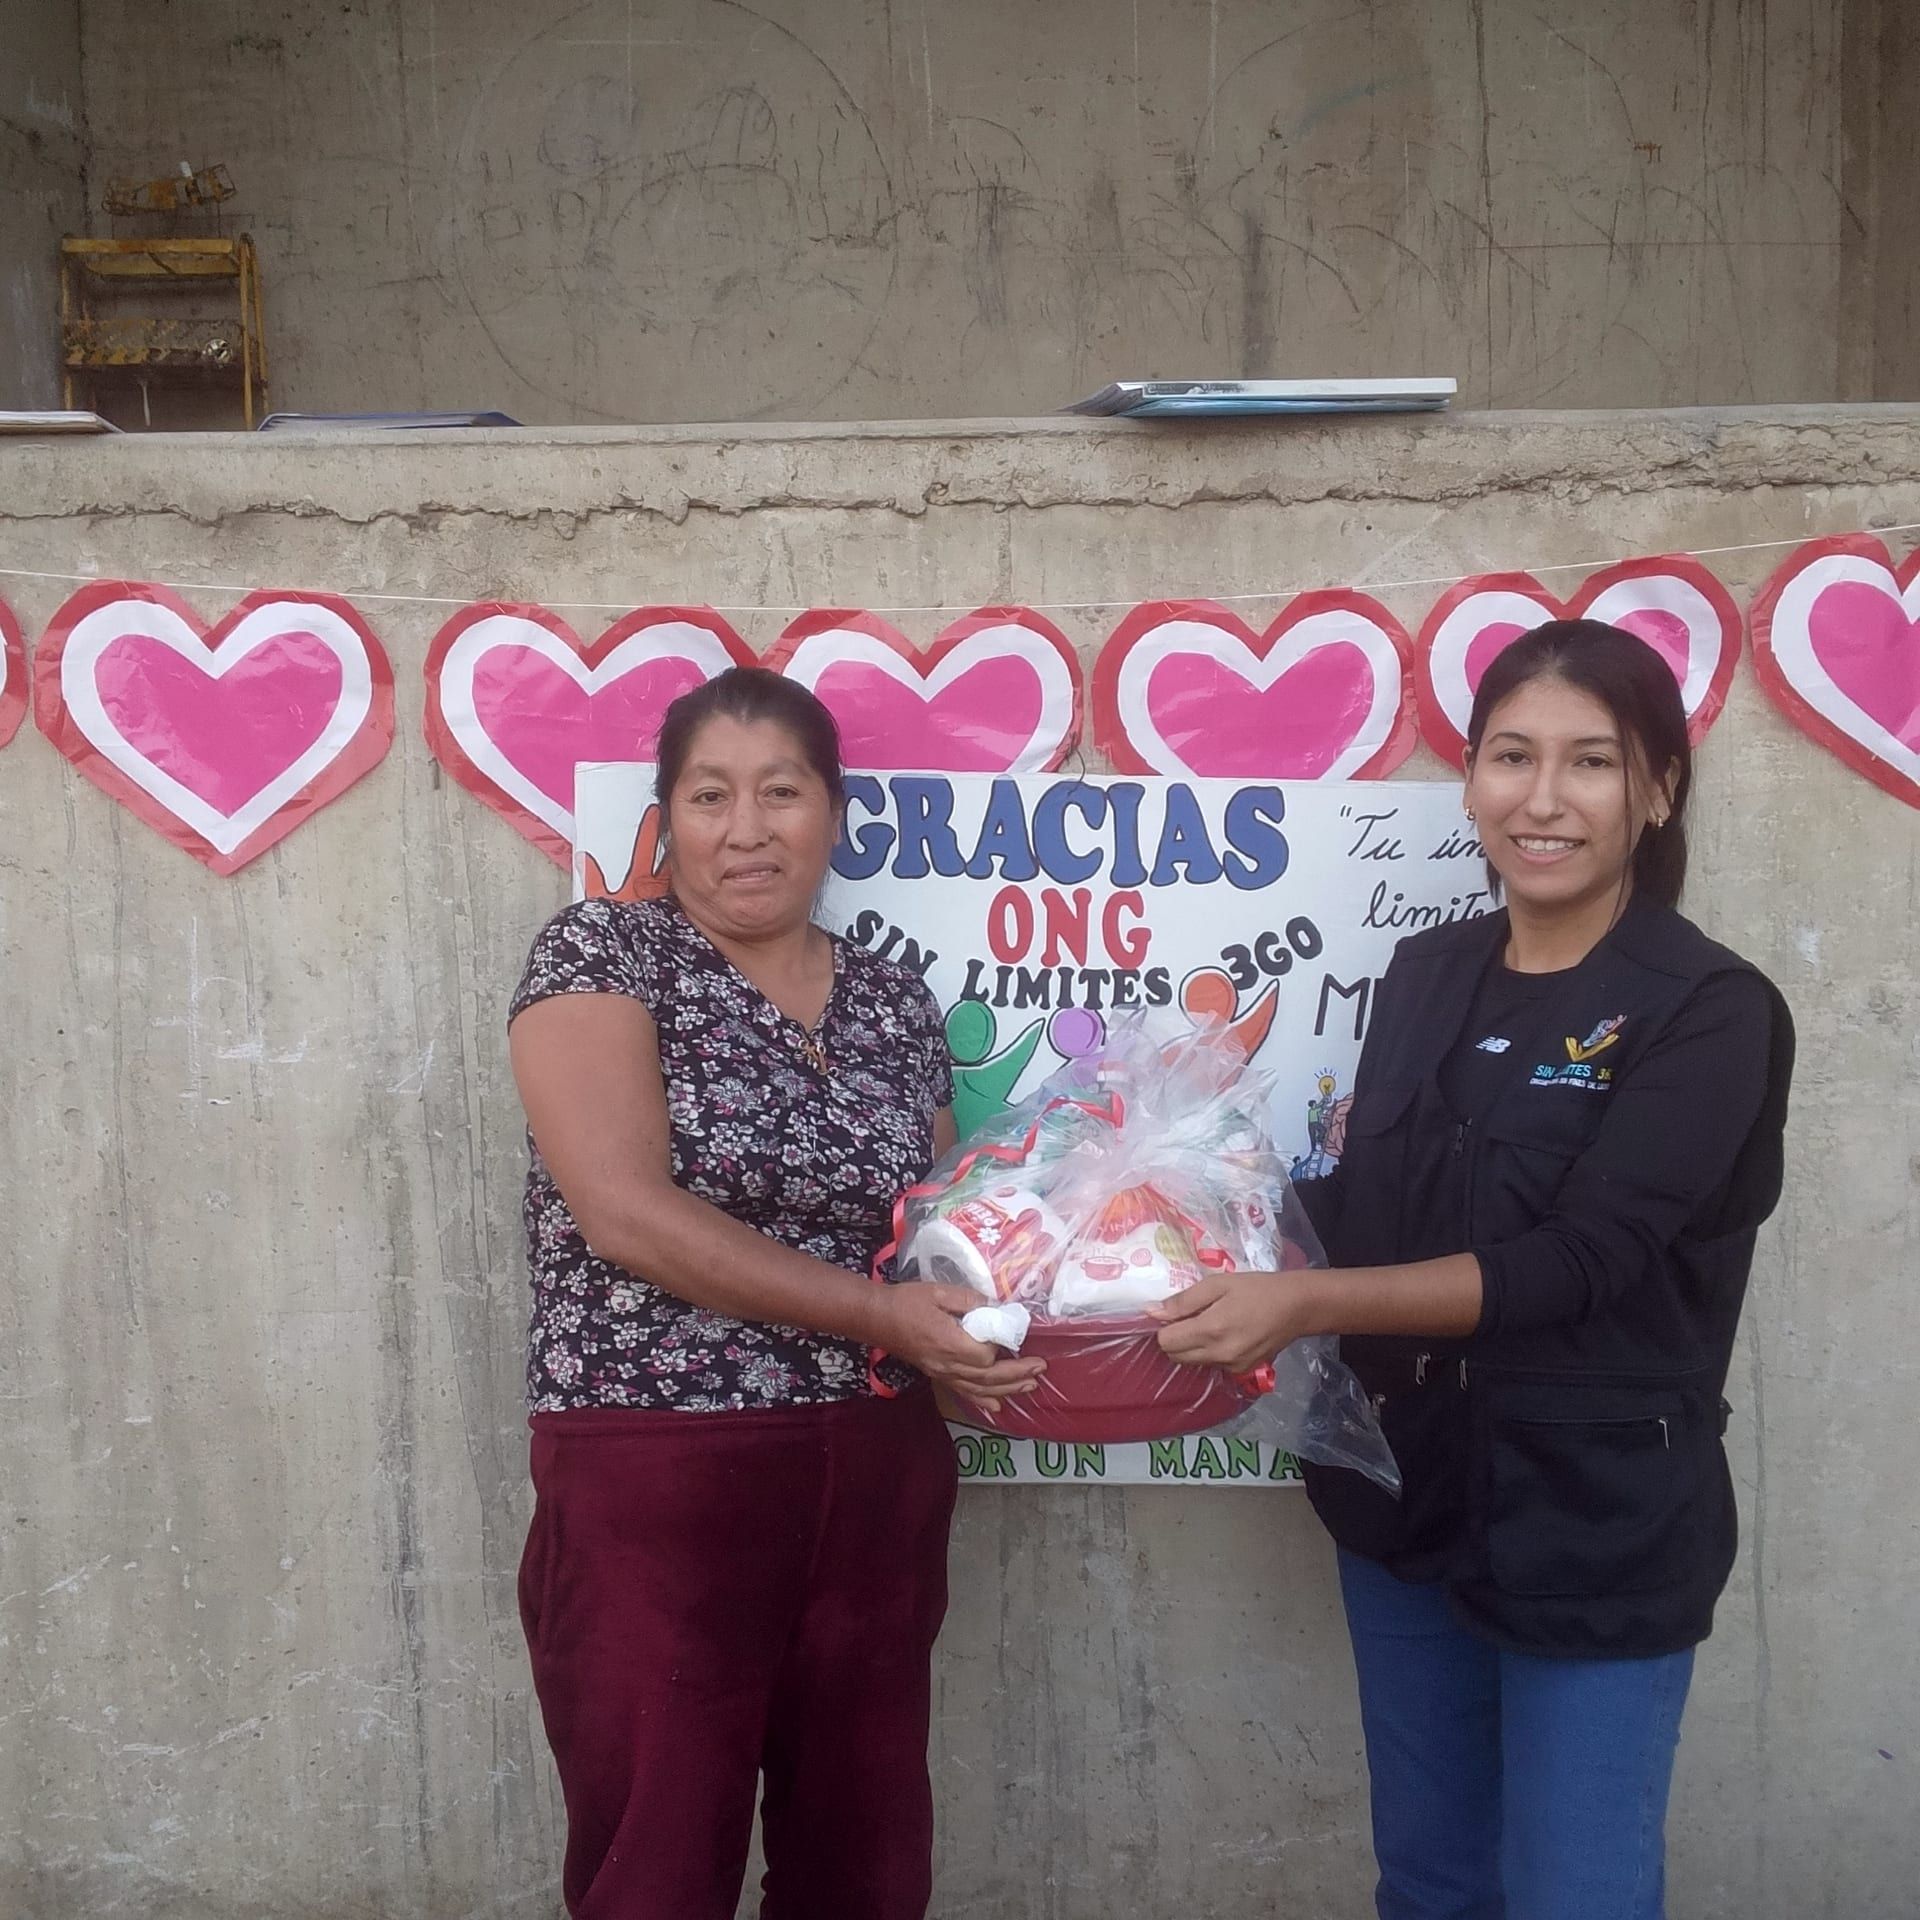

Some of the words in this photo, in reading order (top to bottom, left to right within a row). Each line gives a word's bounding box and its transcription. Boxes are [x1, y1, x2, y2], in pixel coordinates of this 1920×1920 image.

[829, 775, 1289, 889] GRACIAS
[846, 910, 938, 977] SIN
[960, 958, 1173, 1009] LIMITES
[987, 884, 1152, 970] ONG
[1535, 1064, 1555, 1079] SIN
[1033, 1440, 1106, 1478] UN
